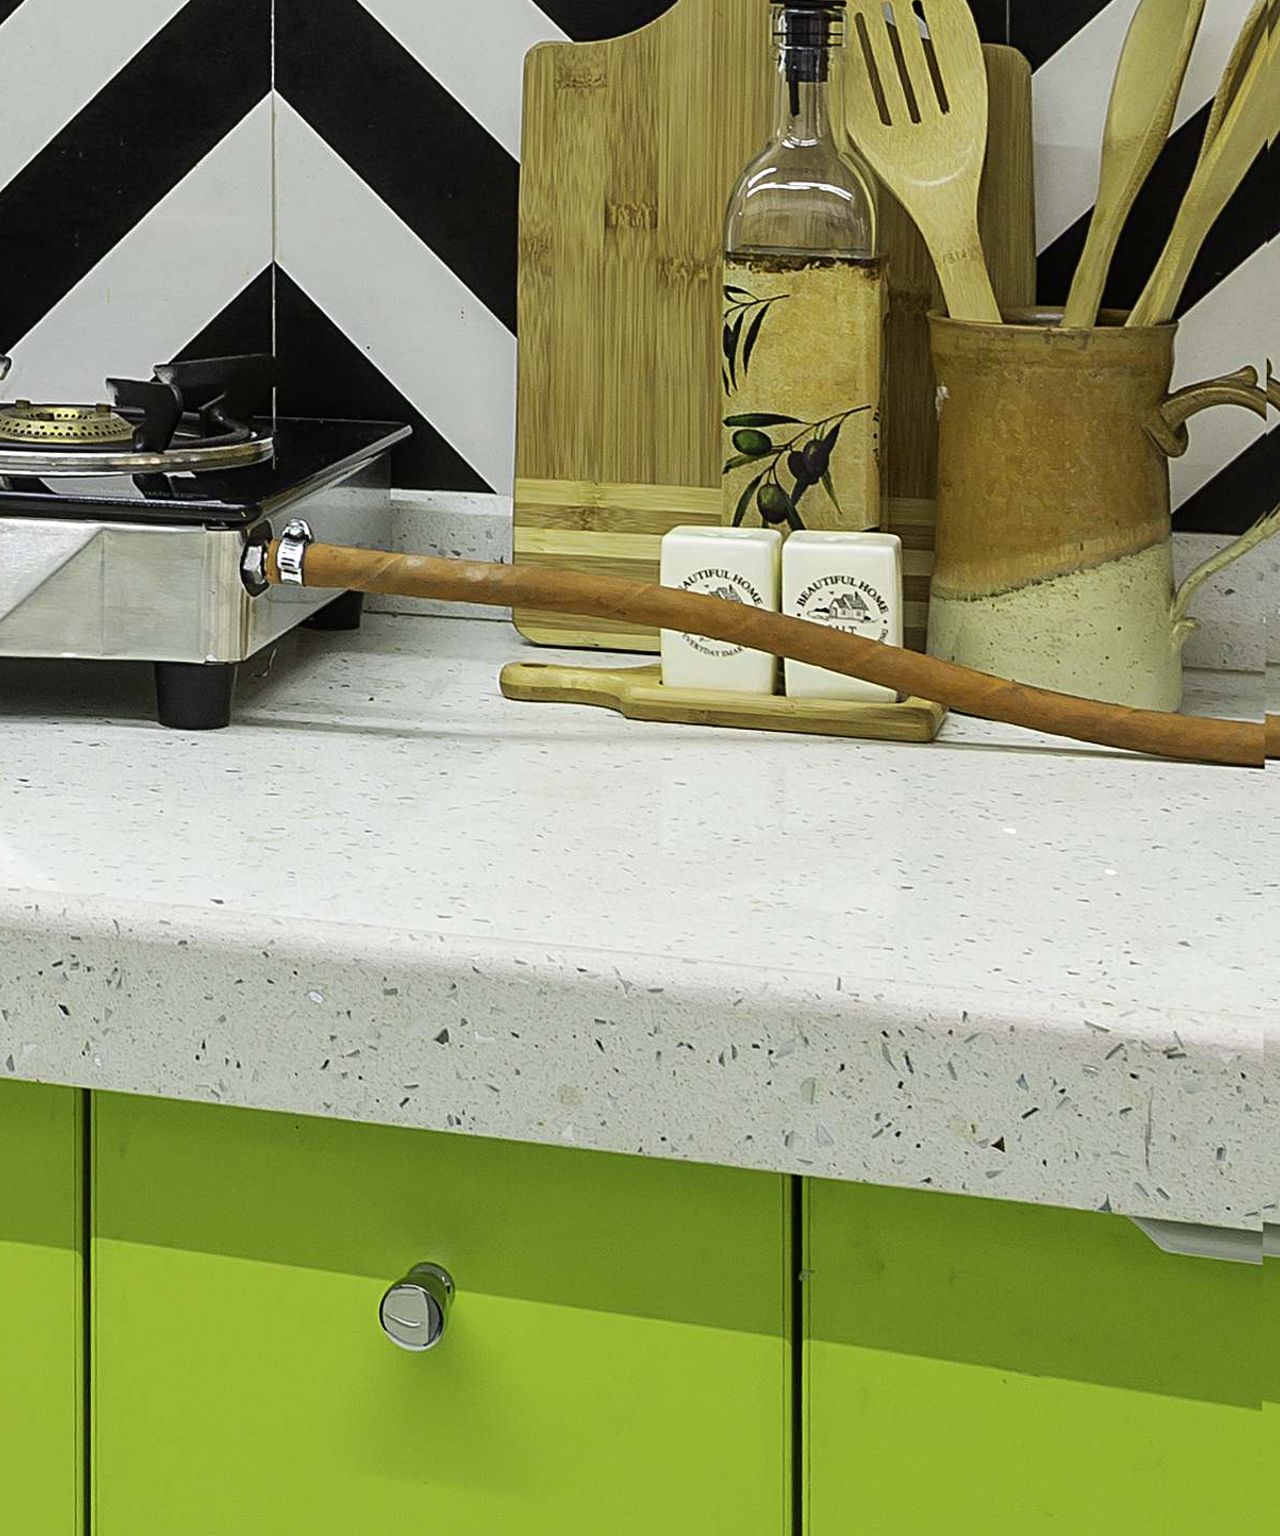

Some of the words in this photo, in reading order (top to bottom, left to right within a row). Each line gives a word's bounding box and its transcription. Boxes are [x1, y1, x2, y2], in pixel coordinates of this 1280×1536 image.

[677, 568, 731, 590] AUTIFUL
[732, 573, 764, 606] HOME
[796, 574, 858, 608] BEAUTIFUL
[858, 580, 889, 615] HOME
